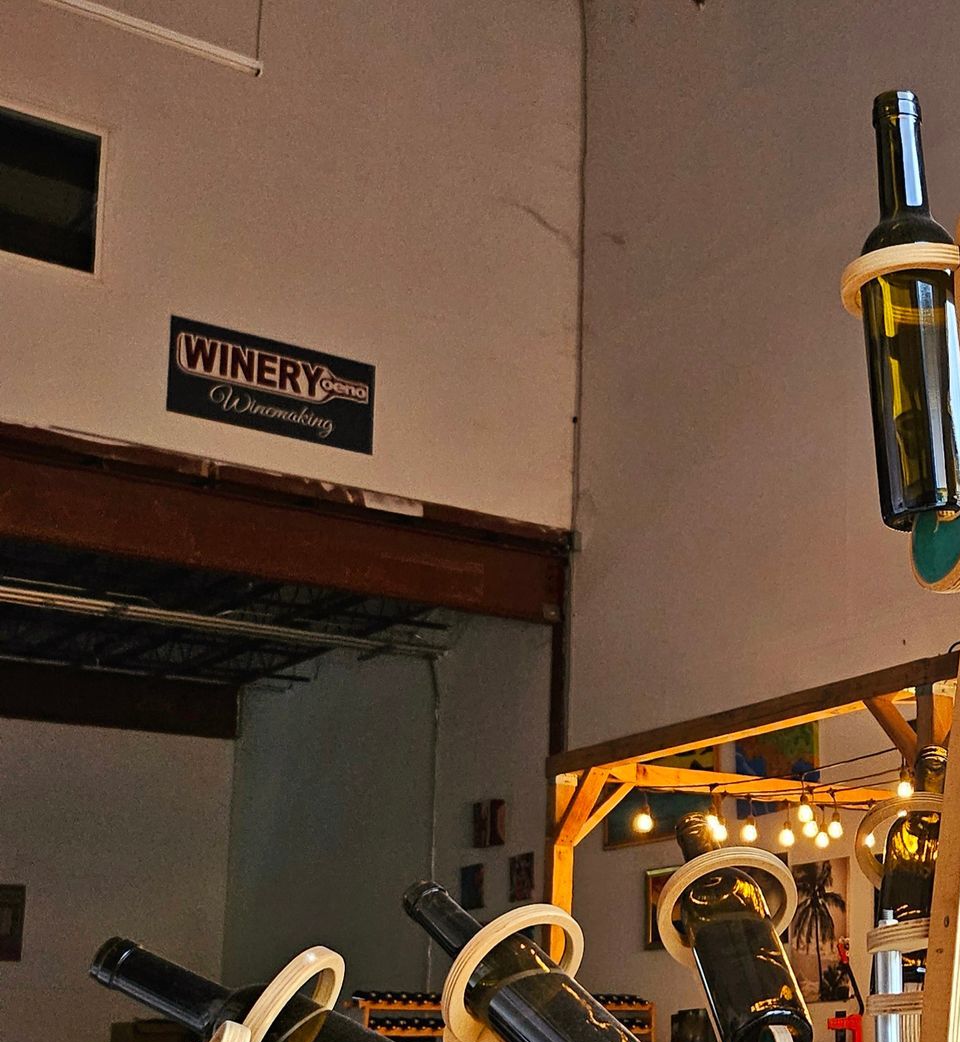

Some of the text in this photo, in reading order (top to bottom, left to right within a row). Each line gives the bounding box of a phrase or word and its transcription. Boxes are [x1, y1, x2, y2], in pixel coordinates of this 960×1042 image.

[184, 335, 366, 399] WINERY oeno
[209, 384, 334, 438] Winemaking
